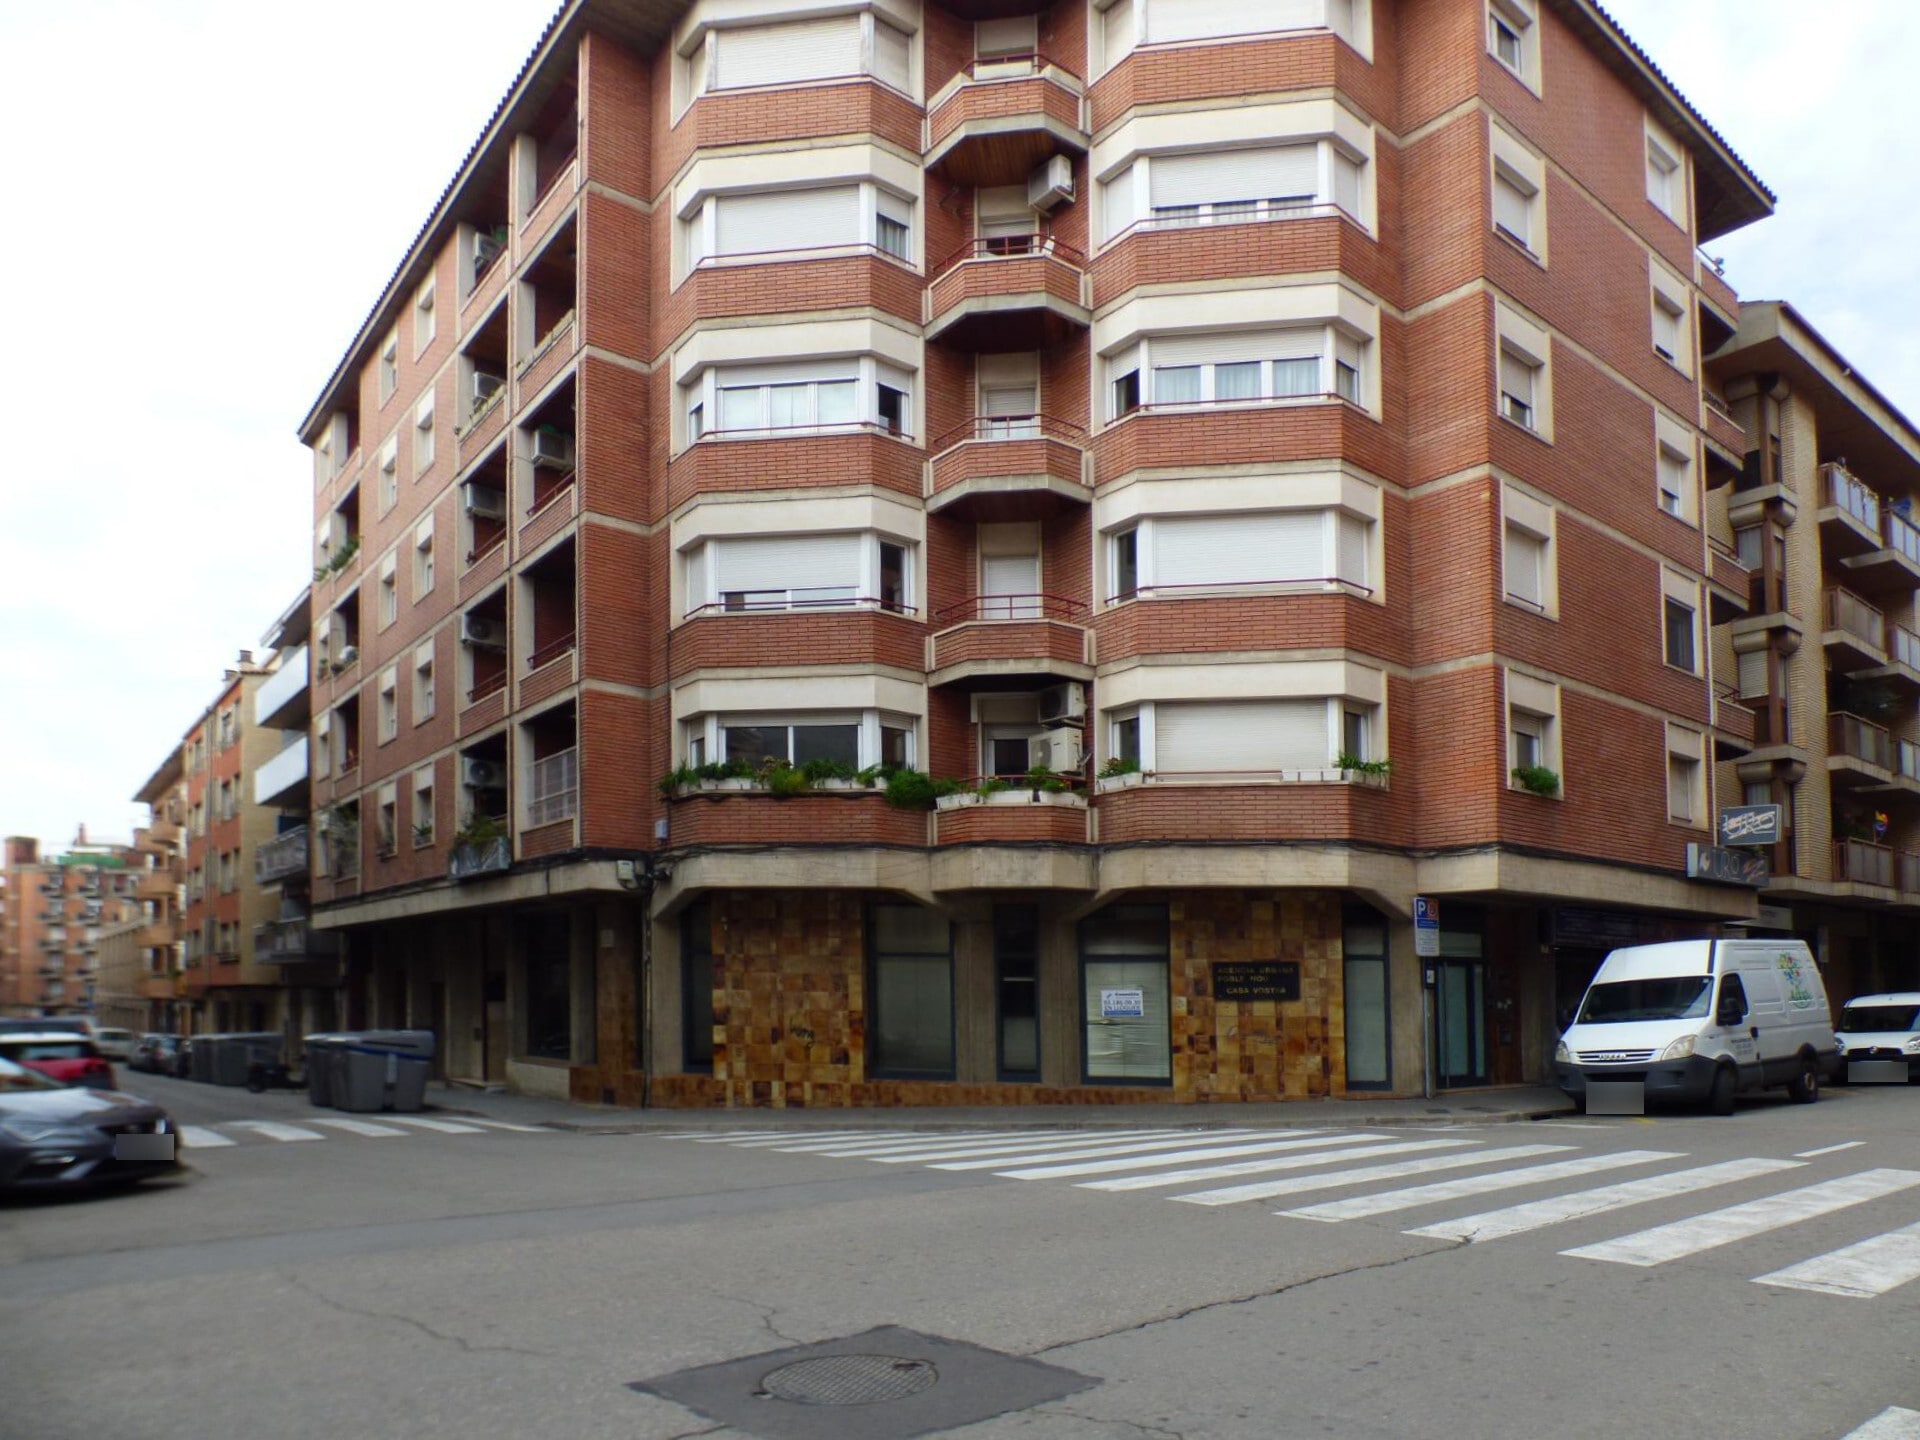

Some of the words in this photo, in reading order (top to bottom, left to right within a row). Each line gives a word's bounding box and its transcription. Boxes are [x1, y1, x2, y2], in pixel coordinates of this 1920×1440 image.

[1418, 901, 1426, 915] P
[1226, 986, 1249, 994] CASA
[1253, 986, 1286, 994] VOSTRA
